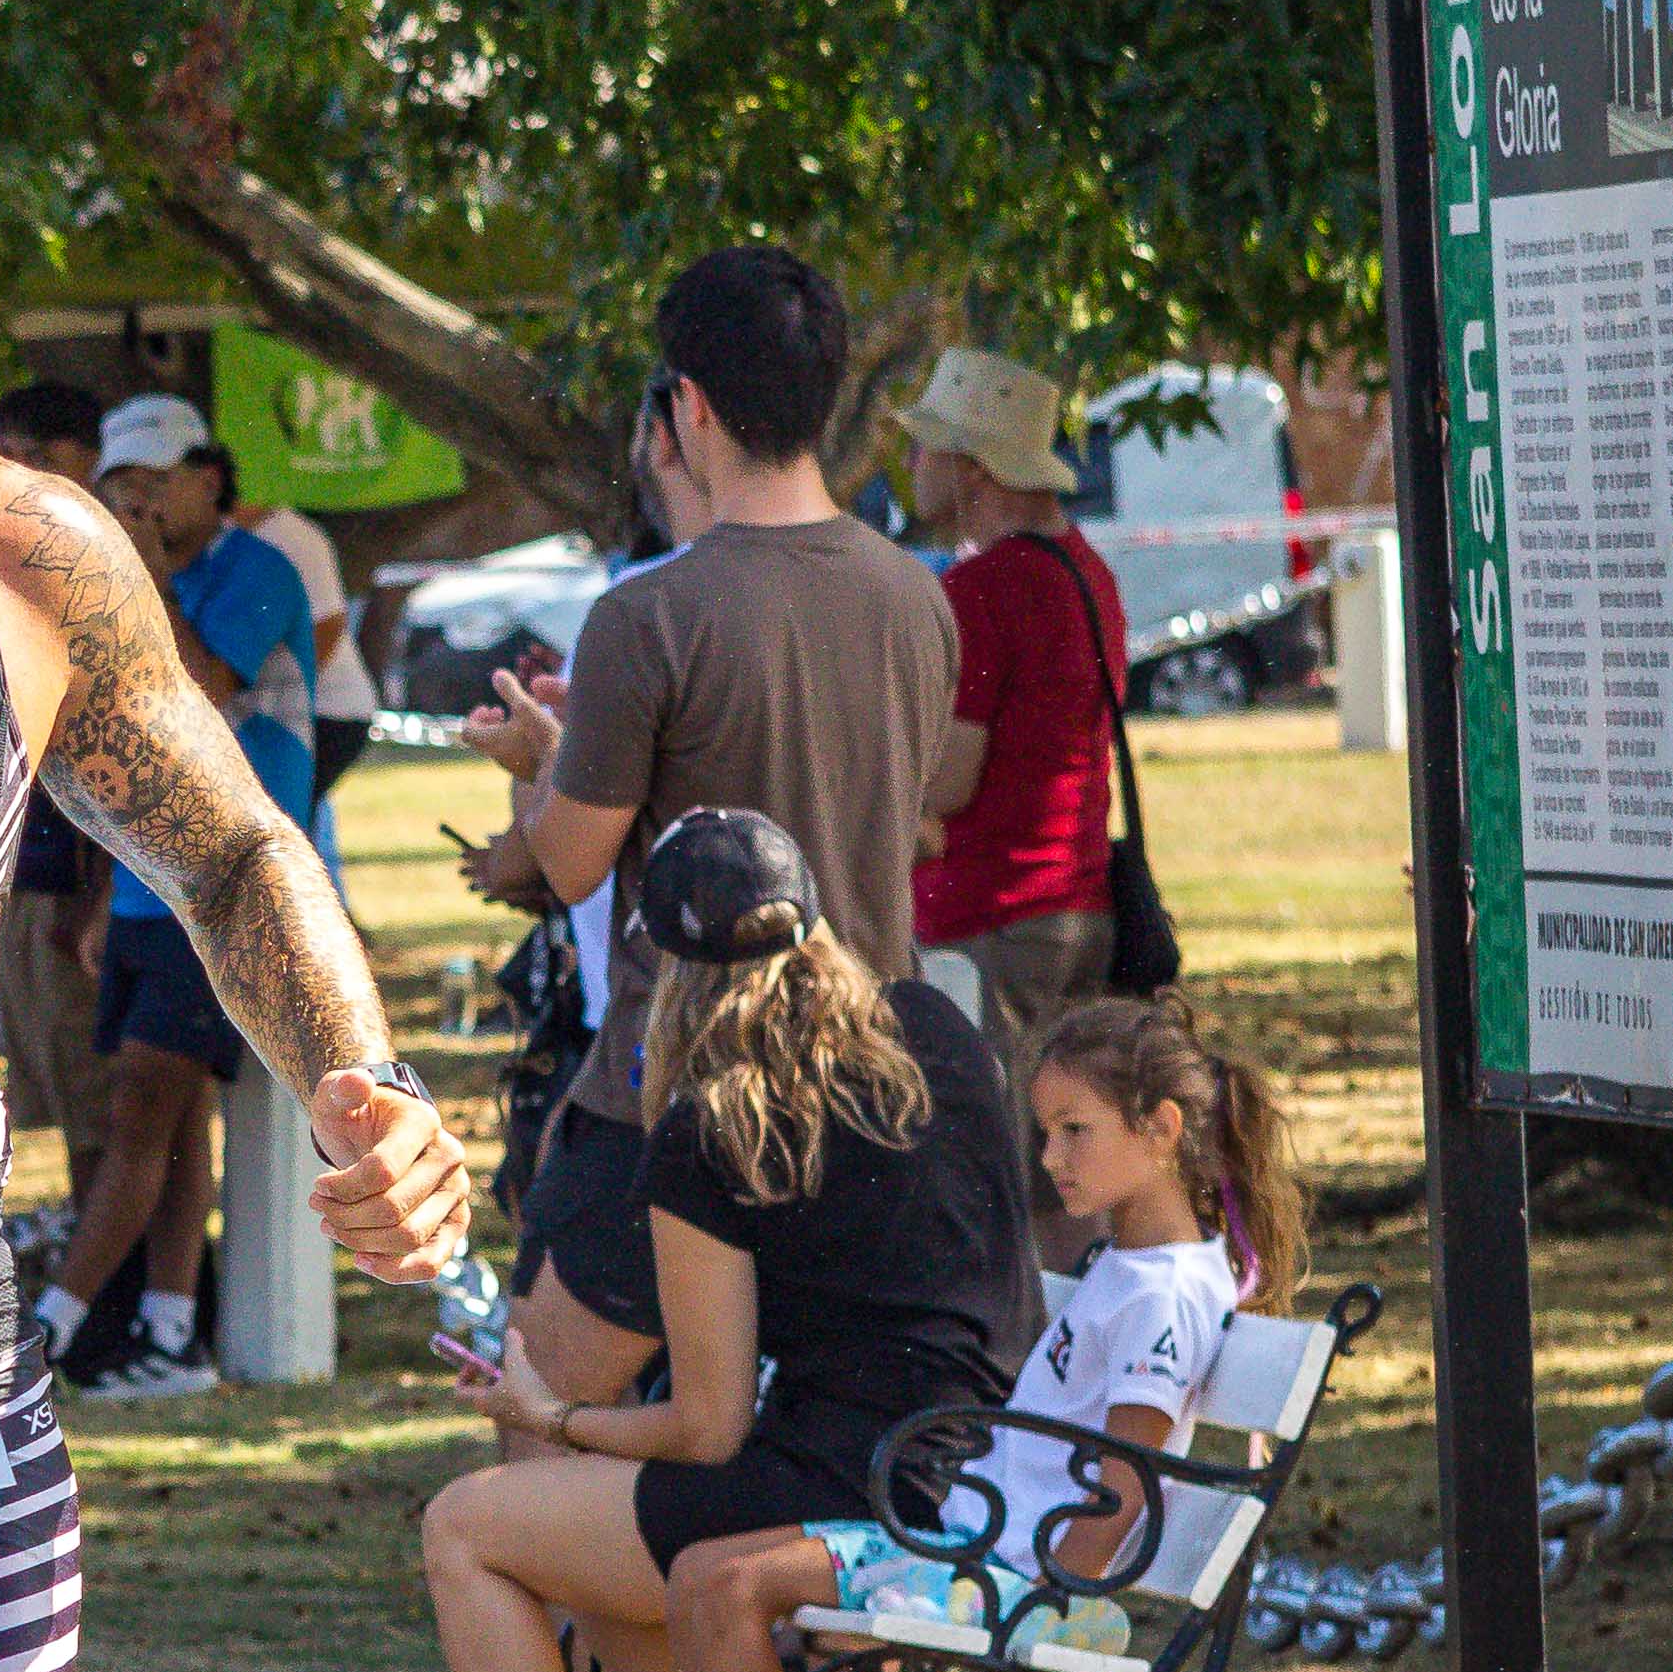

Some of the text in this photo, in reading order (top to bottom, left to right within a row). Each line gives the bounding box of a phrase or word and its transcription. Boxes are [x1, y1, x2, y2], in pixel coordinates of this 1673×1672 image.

[1495, 62, 1562, 159] Gloria
[1462, 320, 1503, 654] San
[1537, 912, 1611, 954] MUNICIPALIDAD
[1614, 917, 1626, 956] DE
[1647, 919, 1673, 961] LORE
[1539, 979, 1589, 1021] GESTIÓN
[1596, 991, 1610, 1025] DE
